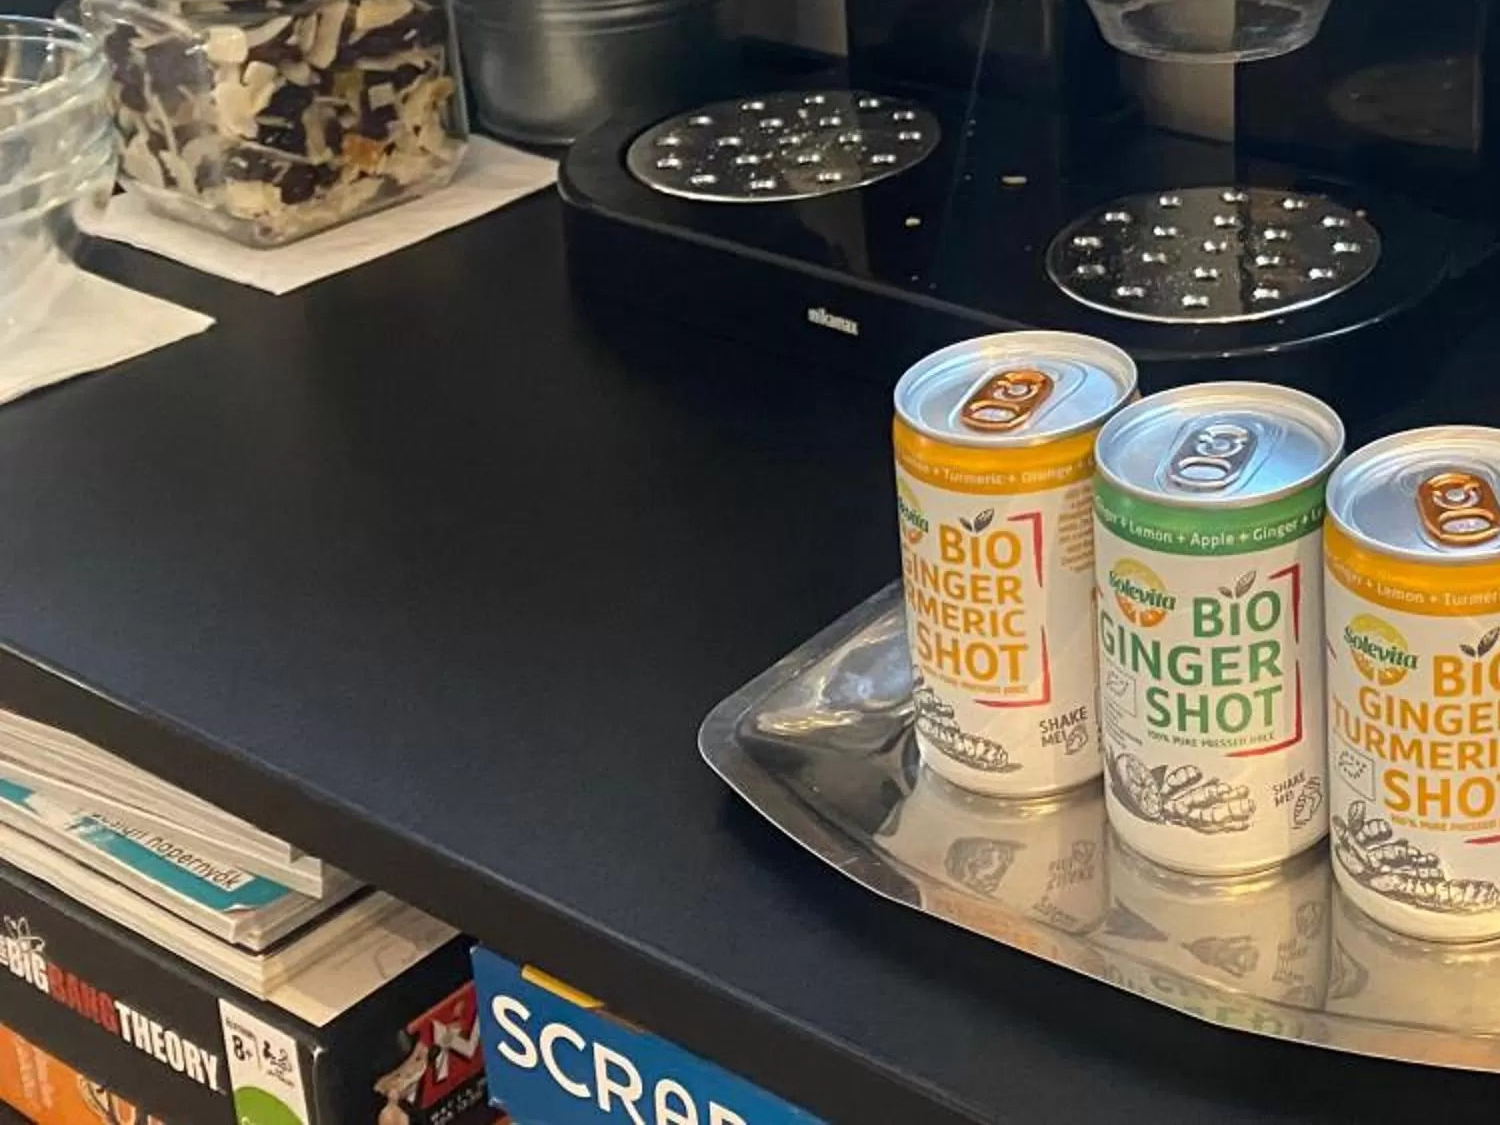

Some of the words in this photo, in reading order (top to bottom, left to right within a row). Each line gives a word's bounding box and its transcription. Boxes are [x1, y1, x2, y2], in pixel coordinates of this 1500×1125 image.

[1128, 520, 1173, 543] Lemon
[1189, 532, 1235, 549] Apple
[1252, 520, 1299, 542] Ginger
[906, 554, 1025, 605] GINGER
[1376, 581, 1424, 604] Lemon
[906, 578, 1026, 638] RMERIC
[917, 621, 1029, 682] SHOT
[1099, 607, 1283, 687] GINGER
[1343, 625, 1419, 669] Solevita
[1039, 706, 1089, 734] SHAKE
[1145, 684, 1284, 734] SHOT
[113, 1000, 220, 1091] THEORY
